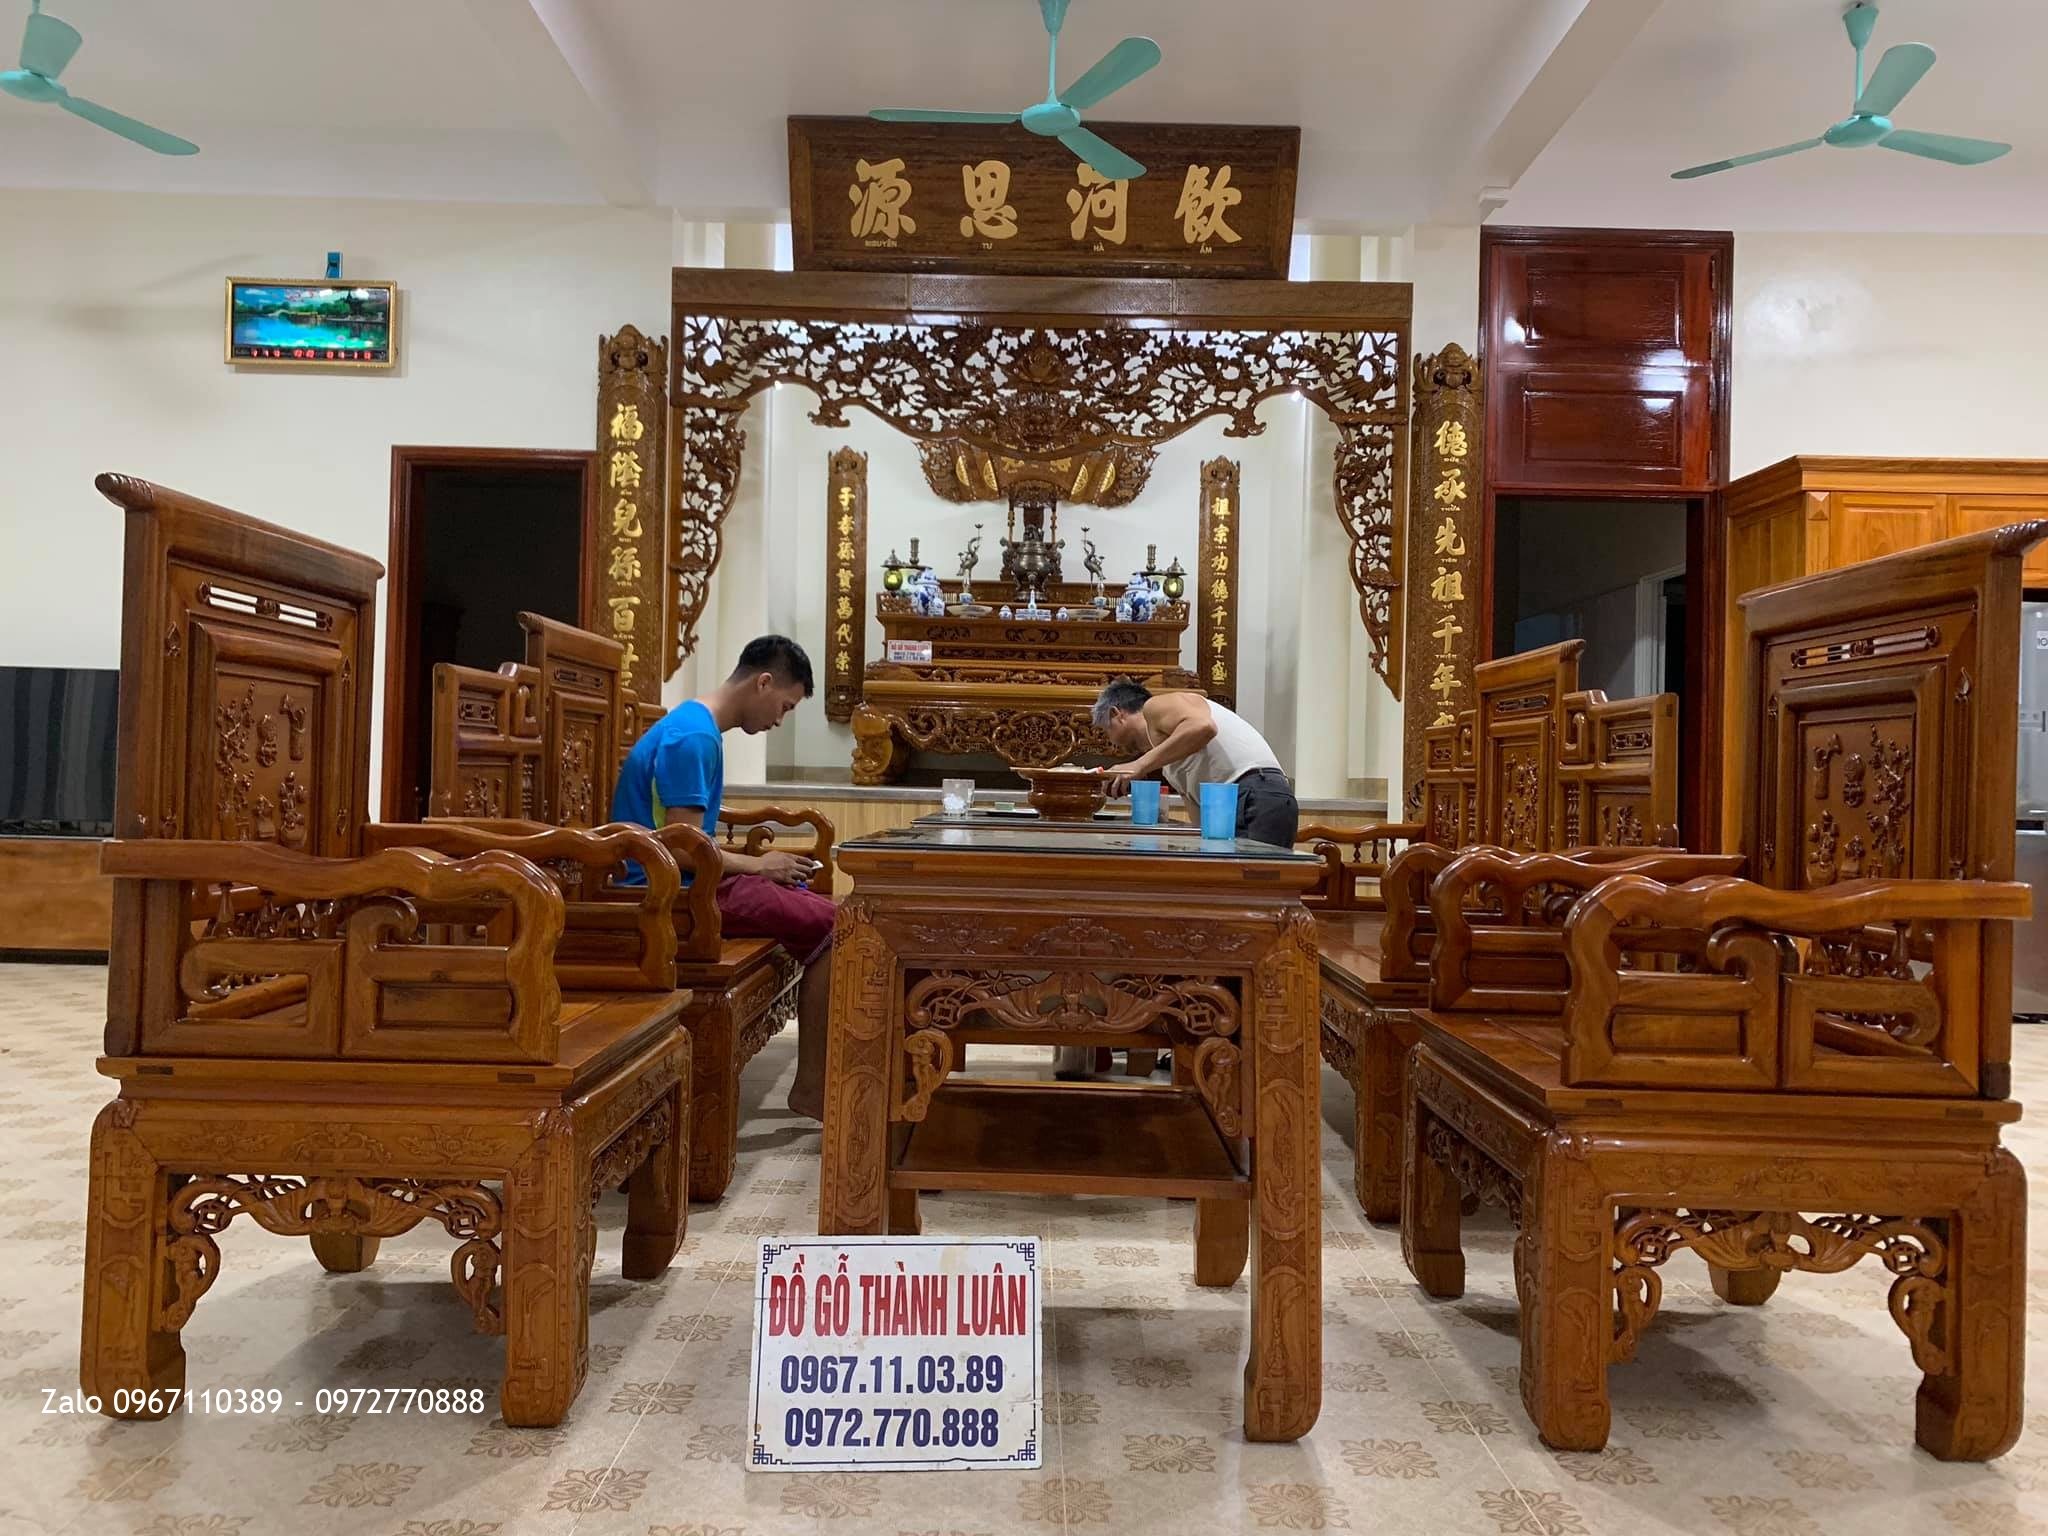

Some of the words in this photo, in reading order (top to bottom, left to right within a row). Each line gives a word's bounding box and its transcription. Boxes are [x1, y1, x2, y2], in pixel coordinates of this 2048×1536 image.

[769, 1253, 806, 1337] ĐỒ
[814, 1253, 851, 1337] GỖ
[859, 1261, 948, 1336] THÀNH
[956, 1263, 1027, 1336] LUÂN
[780, 1354, 1004, 1394] 0967.11.03.89
[784, 1407, 1000, 1448] 0972.770.888
